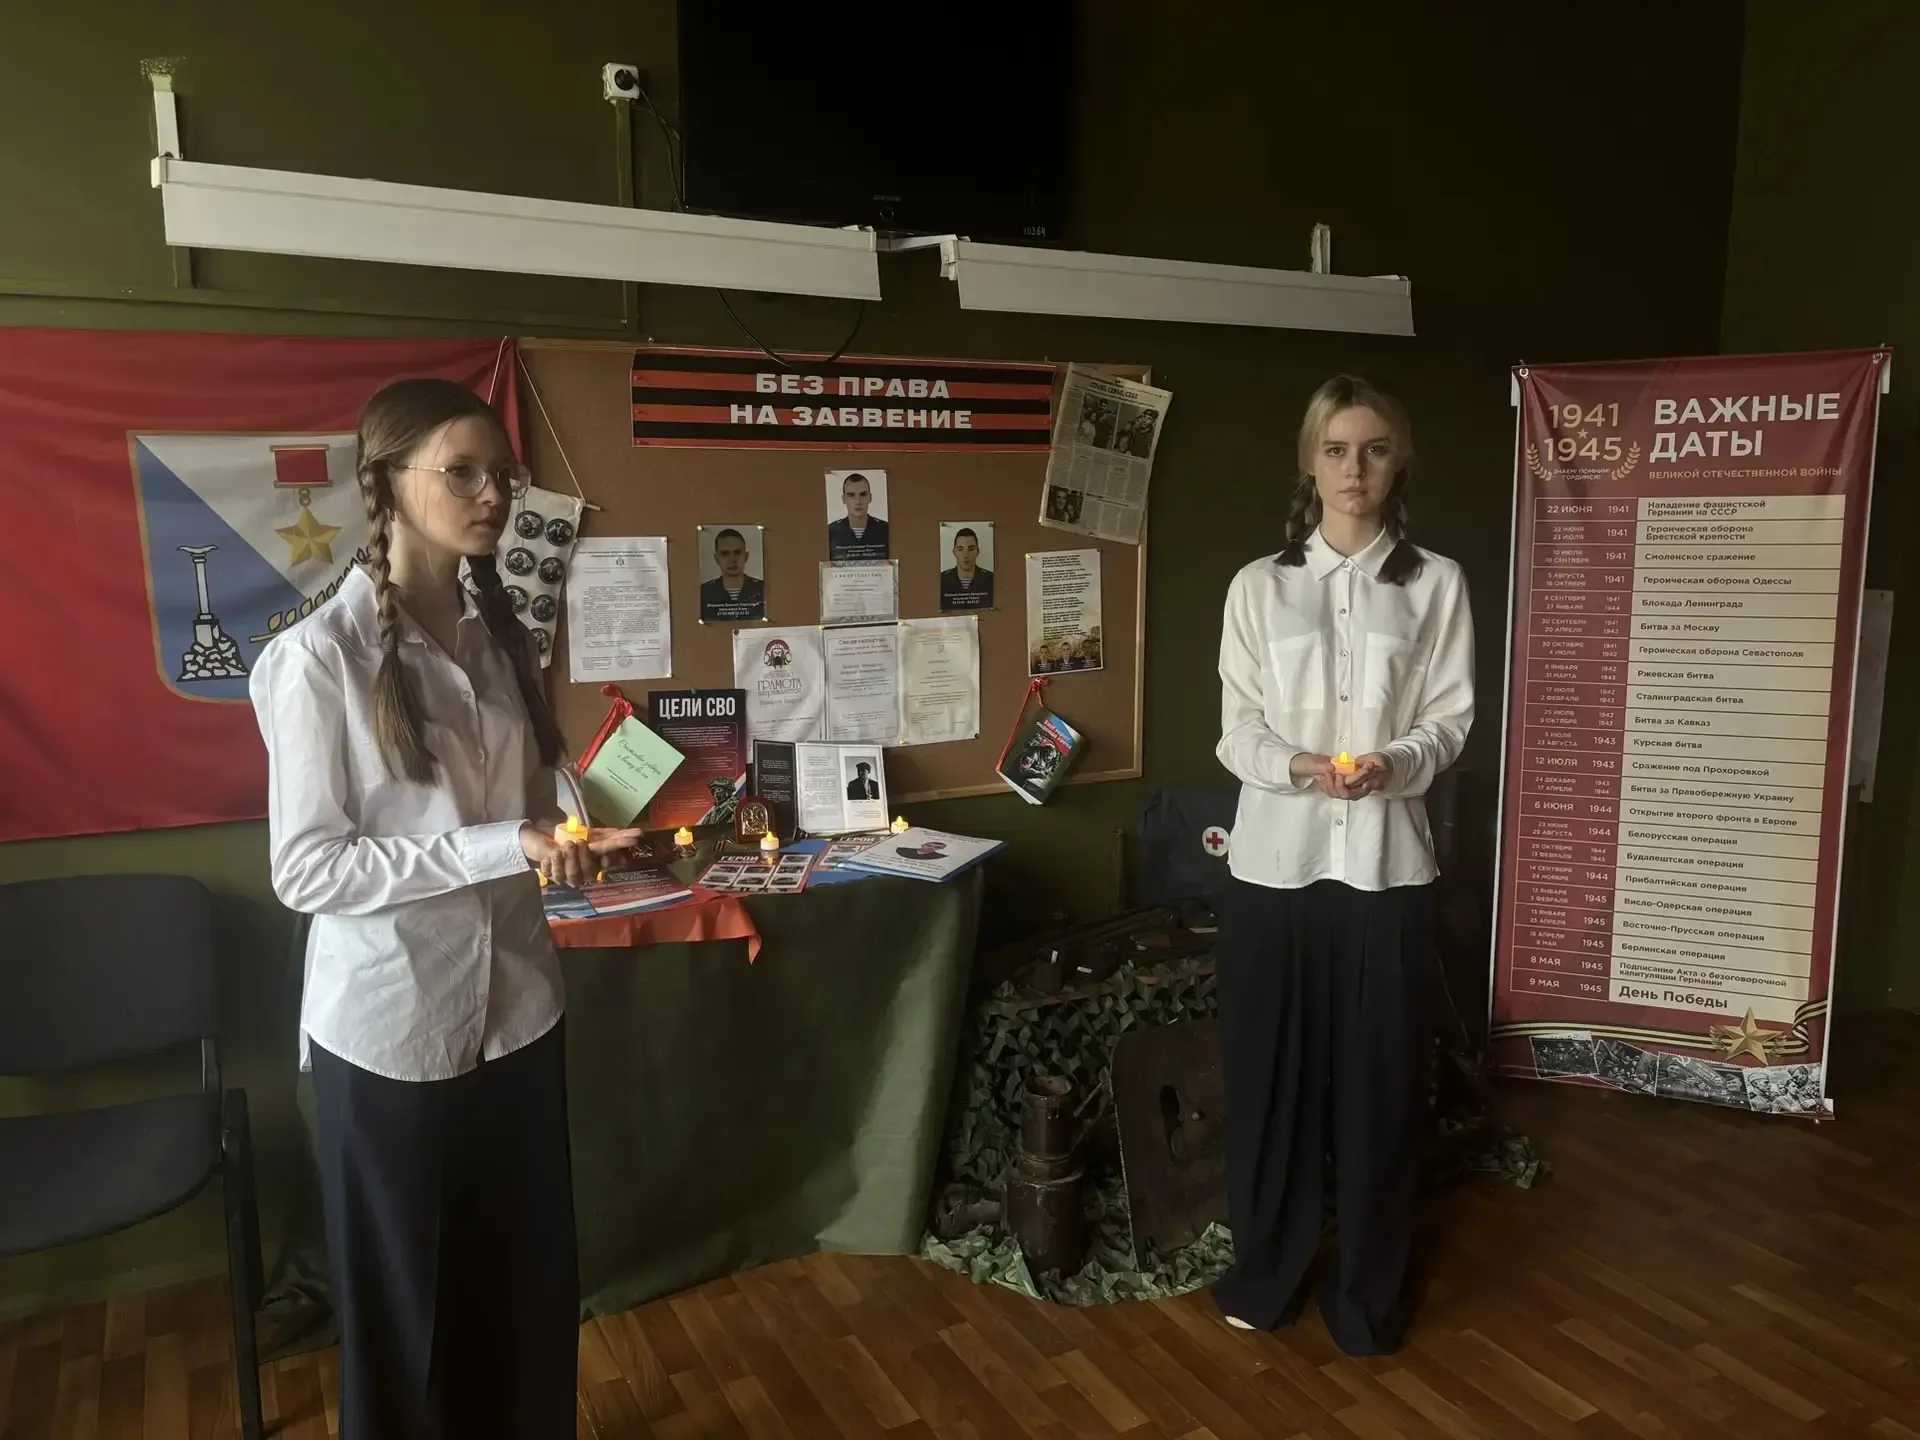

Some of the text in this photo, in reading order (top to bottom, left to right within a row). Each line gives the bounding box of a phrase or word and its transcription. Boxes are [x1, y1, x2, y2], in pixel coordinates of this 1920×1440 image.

[756, 374, 950, 399] БЕЗ ПРАВА
[1654, 392, 1841, 425] ВАЖНЫЕ
[730, 404, 972, 429] НА ЗАБВЕНИЕ
[1548, 402, 1619, 428] 1941
[1544, 437, 1622, 462] 1945
[1649, 430, 1762, 463] ДАТЫ
[1649, 467, 1842, 480] ВЕЛИКОЙ ОТЕЧЕСТВЕННОЙ ВОЙНЫ
[1547, 505, 1592, 514] 22 ИЮНЯ
[1608, 505, 1629, 513] 1941
[1648, 500, 1766, 510] Нападение фашистской
[1607, 528, 1628, 537] 1941
[1646, 525, 1707, 534] Героическая
[1646, 533, 1745, 542] Брестской крепости
[1606, 552, 1626, 560] 1941
[1706, 553, 1756, 562] сражение
[1604, 575, 1625, 583] 1941
[1643, 577, 1704, 586] Героическая
[1753, 577, 1791, 586] Одессы
[1642, 599, 1743, 609] Блокада Ленинграда
[1641, 623, 1667, 631] Битва
[1684, 623, 1719, 633] Москву
[1639, 646, 1697, 656] Героическая
[1742, 649, 1804, 658] Севастополя
[1638, 670, 1714, 680] Ржевская битва
[757, 676, 802, 690] ГРАМОТА
[1636, 693, 1712, 704] Сталинградская
[659, 698, 735, 719] ЦЕЛИ СВО
[1635, 716, 1662, 725] Битва
[1594, 736, 1616, 745] 1943
[1634, 740, 1702, 749] Курская битва
[1535, 757, 1577, 766] 12 ИЮЛЯ
[1592, 760, 1615, 768] 1943
[1632, 762, 1769, 777] Сражение под Прохоровкой
[1631, 785, 1657, 794] Битва
[1672, 787, 1750, 800] Правобережную
[1753, 792, 1794, 803] Украину
[1544, 802, 1573, 811] ИЮНЯ
[1589, 805, 1612, 814] 1944
[1630, 807, 1674, 818] Открытие
[1677, 812, 1713, 821] второго
[1716, 812, 1751, 824] фронта
[1762, 818, 1797, 827] Европе
[1588, 828, 1611, 836] 1944
[1628, 830, 1738, 846] Белорусская операция
[1627, 852, 1744, 869] Будапештская операция
[1586, 871, 1608, 880] 1944
[1626, 875, 1747, 893] Прибалтийская операция
[1584, 894, 1607, 903] 1945
[1624, 898, 1752, 917] Висло-Одерская операция
[1583, 916, 1606, 926] 1945
[1623, 921, 1765, 942] Восточно-Прусская операция
[1582, 939, 1604, 948] 1945
[1622, 943, 1726, 961] Берлинская операция
[1531, 956, 1561, 966] 8 МАЯ
[1581, 961, 1603, 970] 1945
[1620, 962, 1674, 974] Подписание
[1677, 969, 1697, 977] Акта
[1709, 972, 1786, 987] безоговорочной
[1620, 970, 1723, 986] капитуляции Германии
[1530, 978, 1560, 988] 9 МАЯ
[1580, 983, 1602, 993] 1945
[1619, 985, 1728, 1009] День Победы
